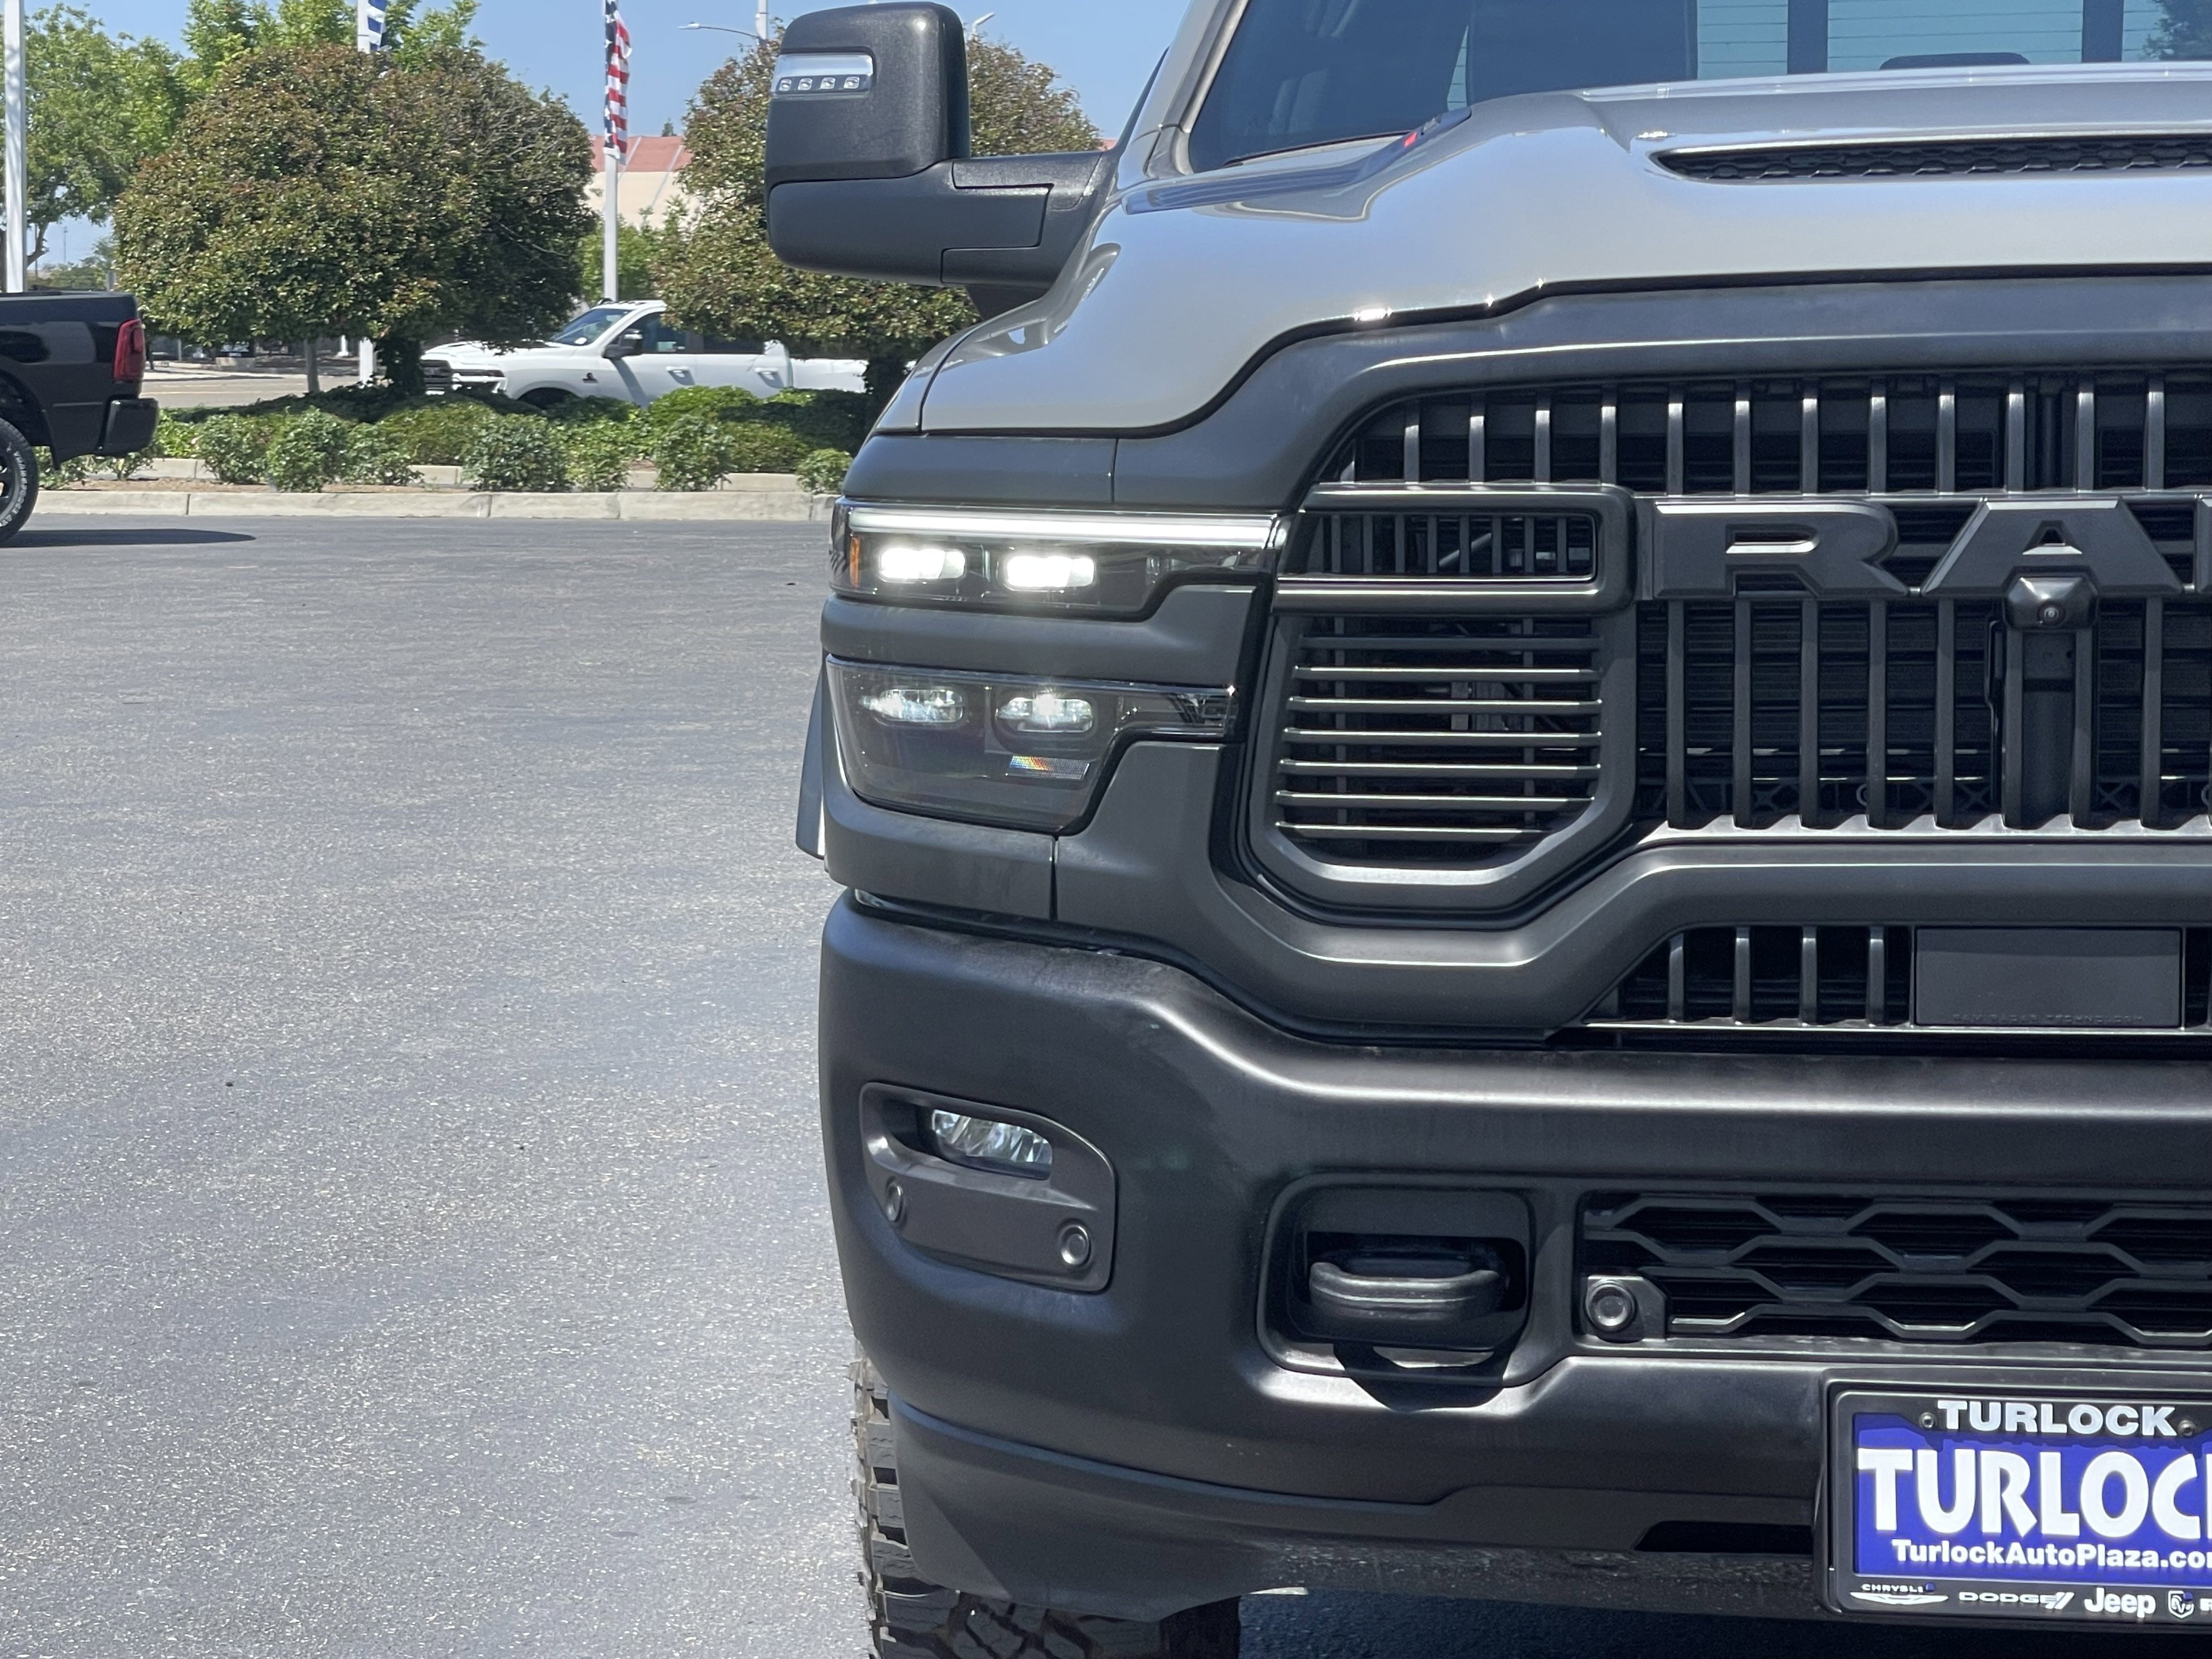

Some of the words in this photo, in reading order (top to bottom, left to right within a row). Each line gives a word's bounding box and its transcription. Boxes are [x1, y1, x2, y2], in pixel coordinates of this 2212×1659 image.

[1653, 496, 2212, 597] RA
[1937, 1400, 2177, 1436] TURLOCK
[1858, 1448, 2212, 1539] TURLOC
[1892, 1539, 2212, 1568] TurlockAutoPlaza.co
[1862, 1583, 1923, 1593] CHRYSL
[1959, 1592, 2057, 1604] DODGE
[2084, 1587, 2156, 1618] Jeep
